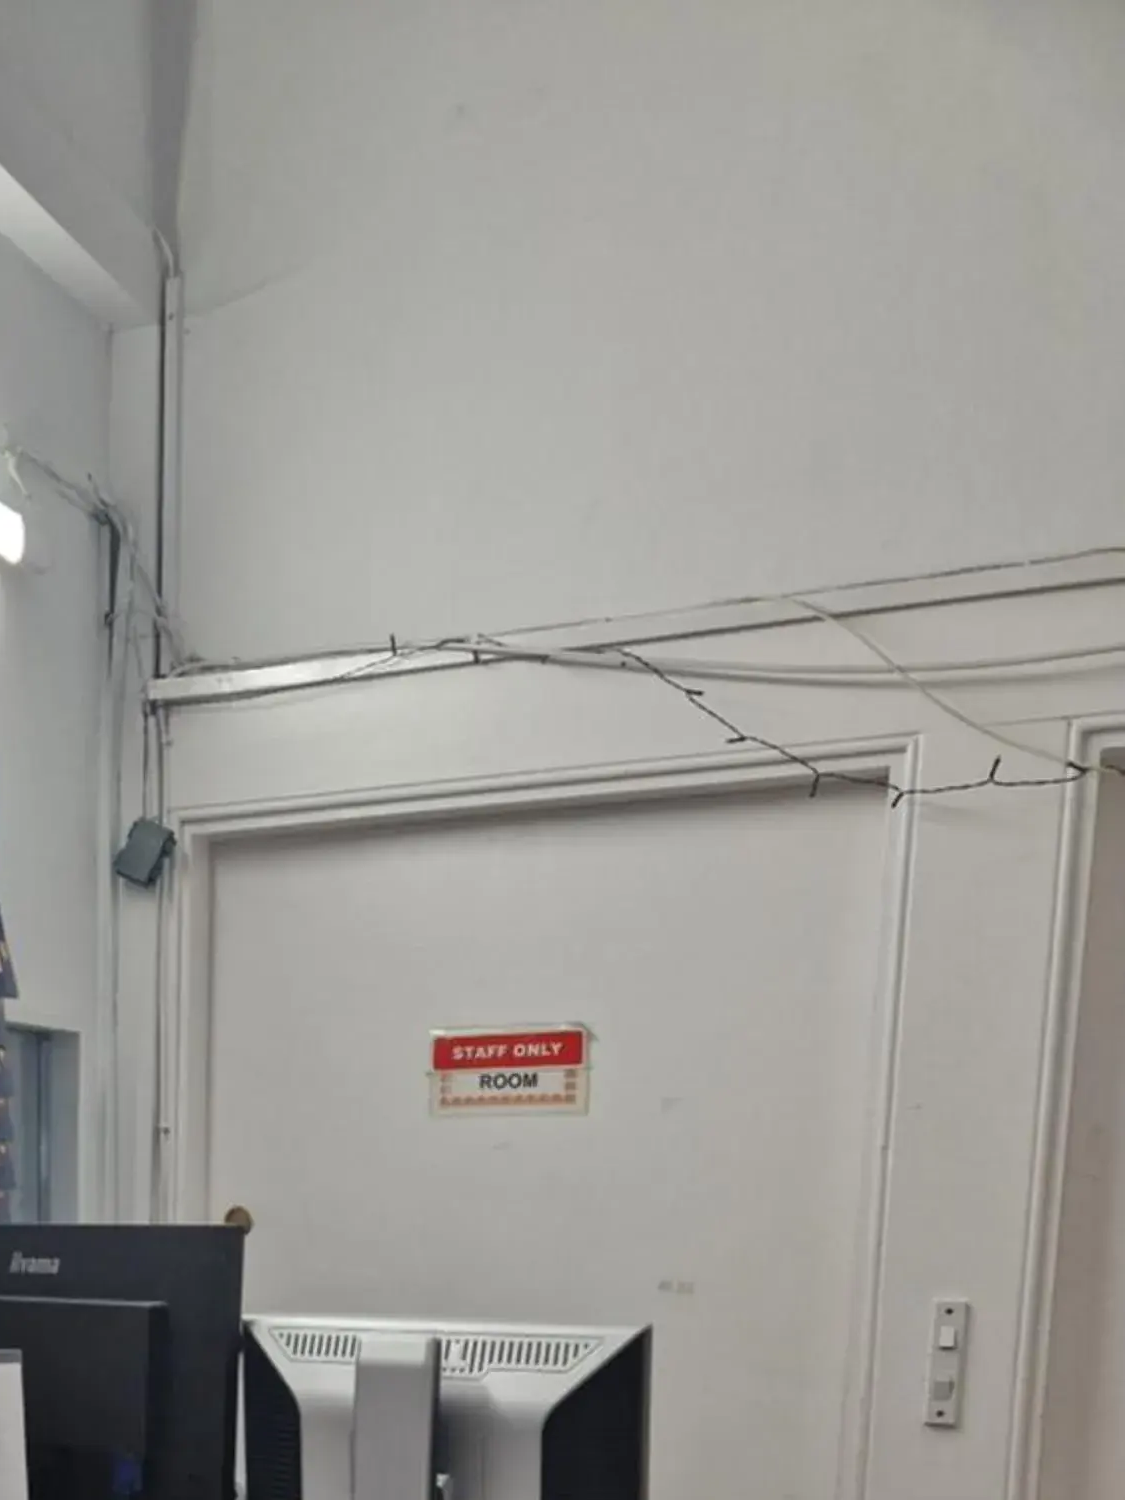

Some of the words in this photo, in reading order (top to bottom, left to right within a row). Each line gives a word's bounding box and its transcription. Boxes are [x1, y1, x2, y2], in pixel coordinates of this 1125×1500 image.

[452, 1044, 507, 1060] STAFF
[513, 1042, 563, 1058] ONLY
[479, 1073, 538, 1089] ROOM
